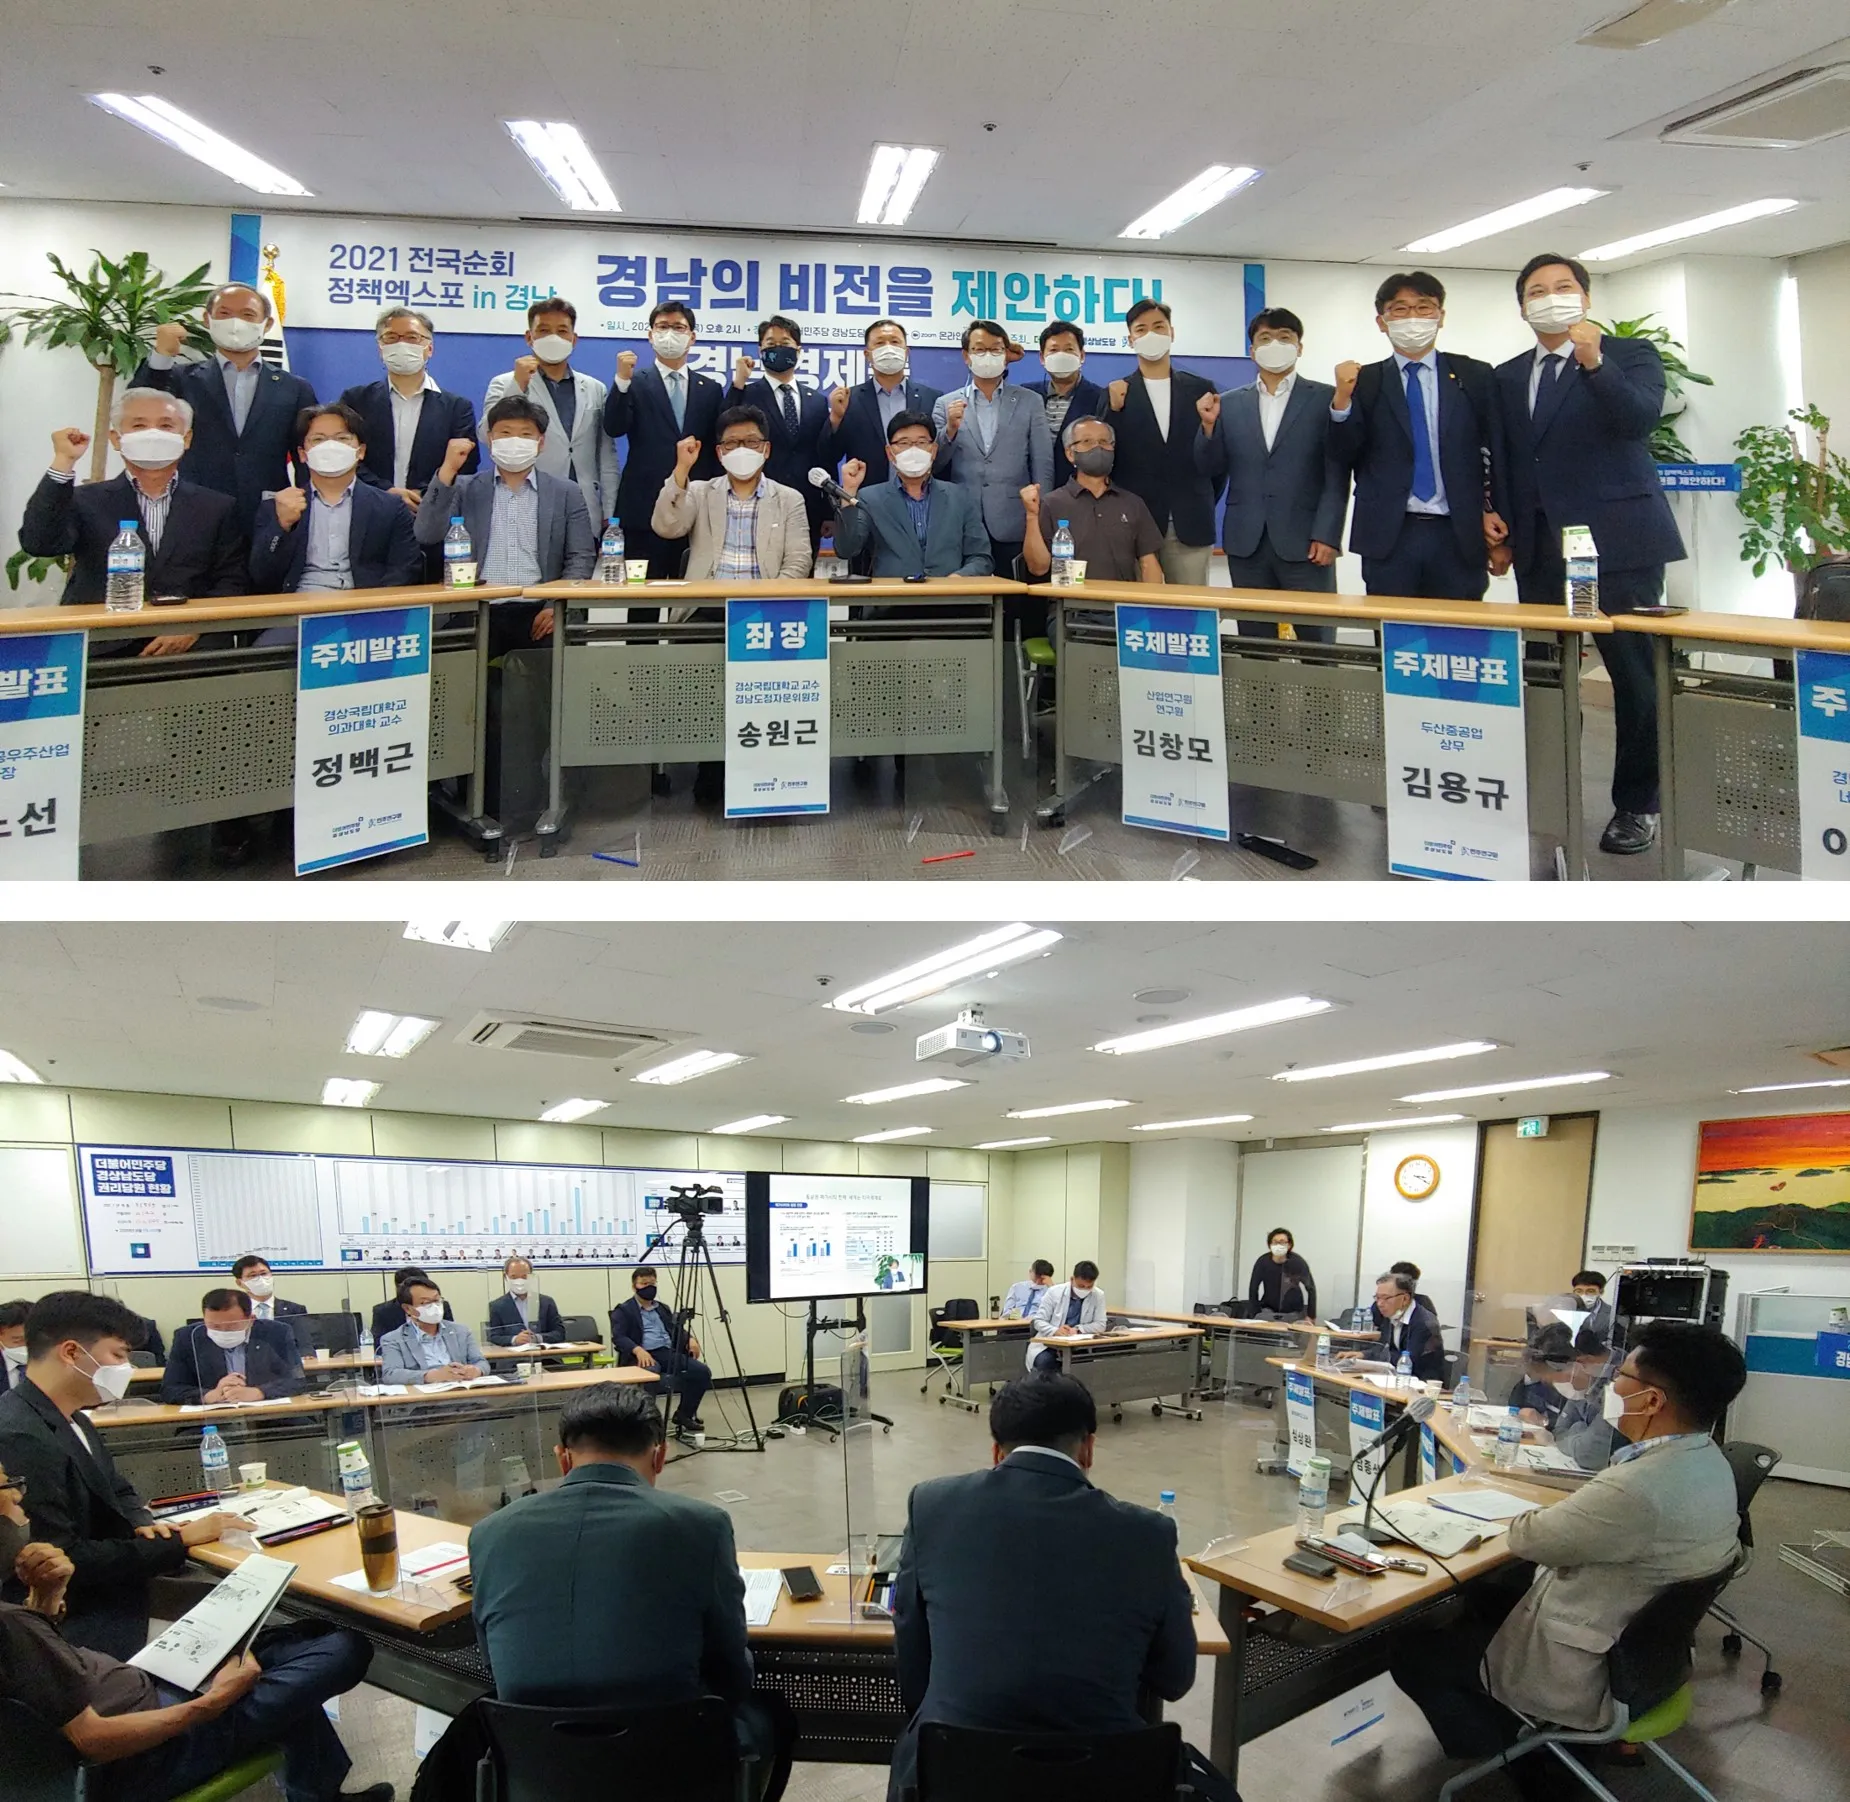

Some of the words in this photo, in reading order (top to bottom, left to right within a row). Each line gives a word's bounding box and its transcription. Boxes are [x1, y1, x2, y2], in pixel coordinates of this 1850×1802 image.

[329, 244, 399, 272] 2021
[408, 246, 514, 277] 전국순회
[327, 277, 465, 309] 정책엑스포
[473, 285, 496, 309] in
[596, 254, 760, 312] 경남의
[779, 263, 934, 318] 비전을
[705, 323, 724, 334] 오후
[726, 324, 741, 334] 2시
[310, 633, 421, 669] 주제발표
[1124, 629, 1211, 658] 주제발표
[1392, 651, 1510, 686] 주제발표
[801, 680, 820, 690] 교수
[1146, 690, 1193, 705] 산업연구원
[324, 699, 407, 722] 경상국립대학교
[1156, 704, 1184, 717] 연구원
[328, 718, 377, 736] 의과대학
[380, 714, 403, 728] 교수
[737, 719, 819, 749] 송원근
[1420, 721, 1483, 740] 두산중공업
[1132, 728, 1214, 763] 김창모
[1440, 738, 1465, 752] 상무
[311, 742, 414, 788] 정백근
[1401, 765, 1510, 812] 김용규
[95, 1158, 167, 1171] 더불어민주당
[97, 1170, 157, 1182] 경상남도당
[98, 1182, 146, 1194] 권리당원
